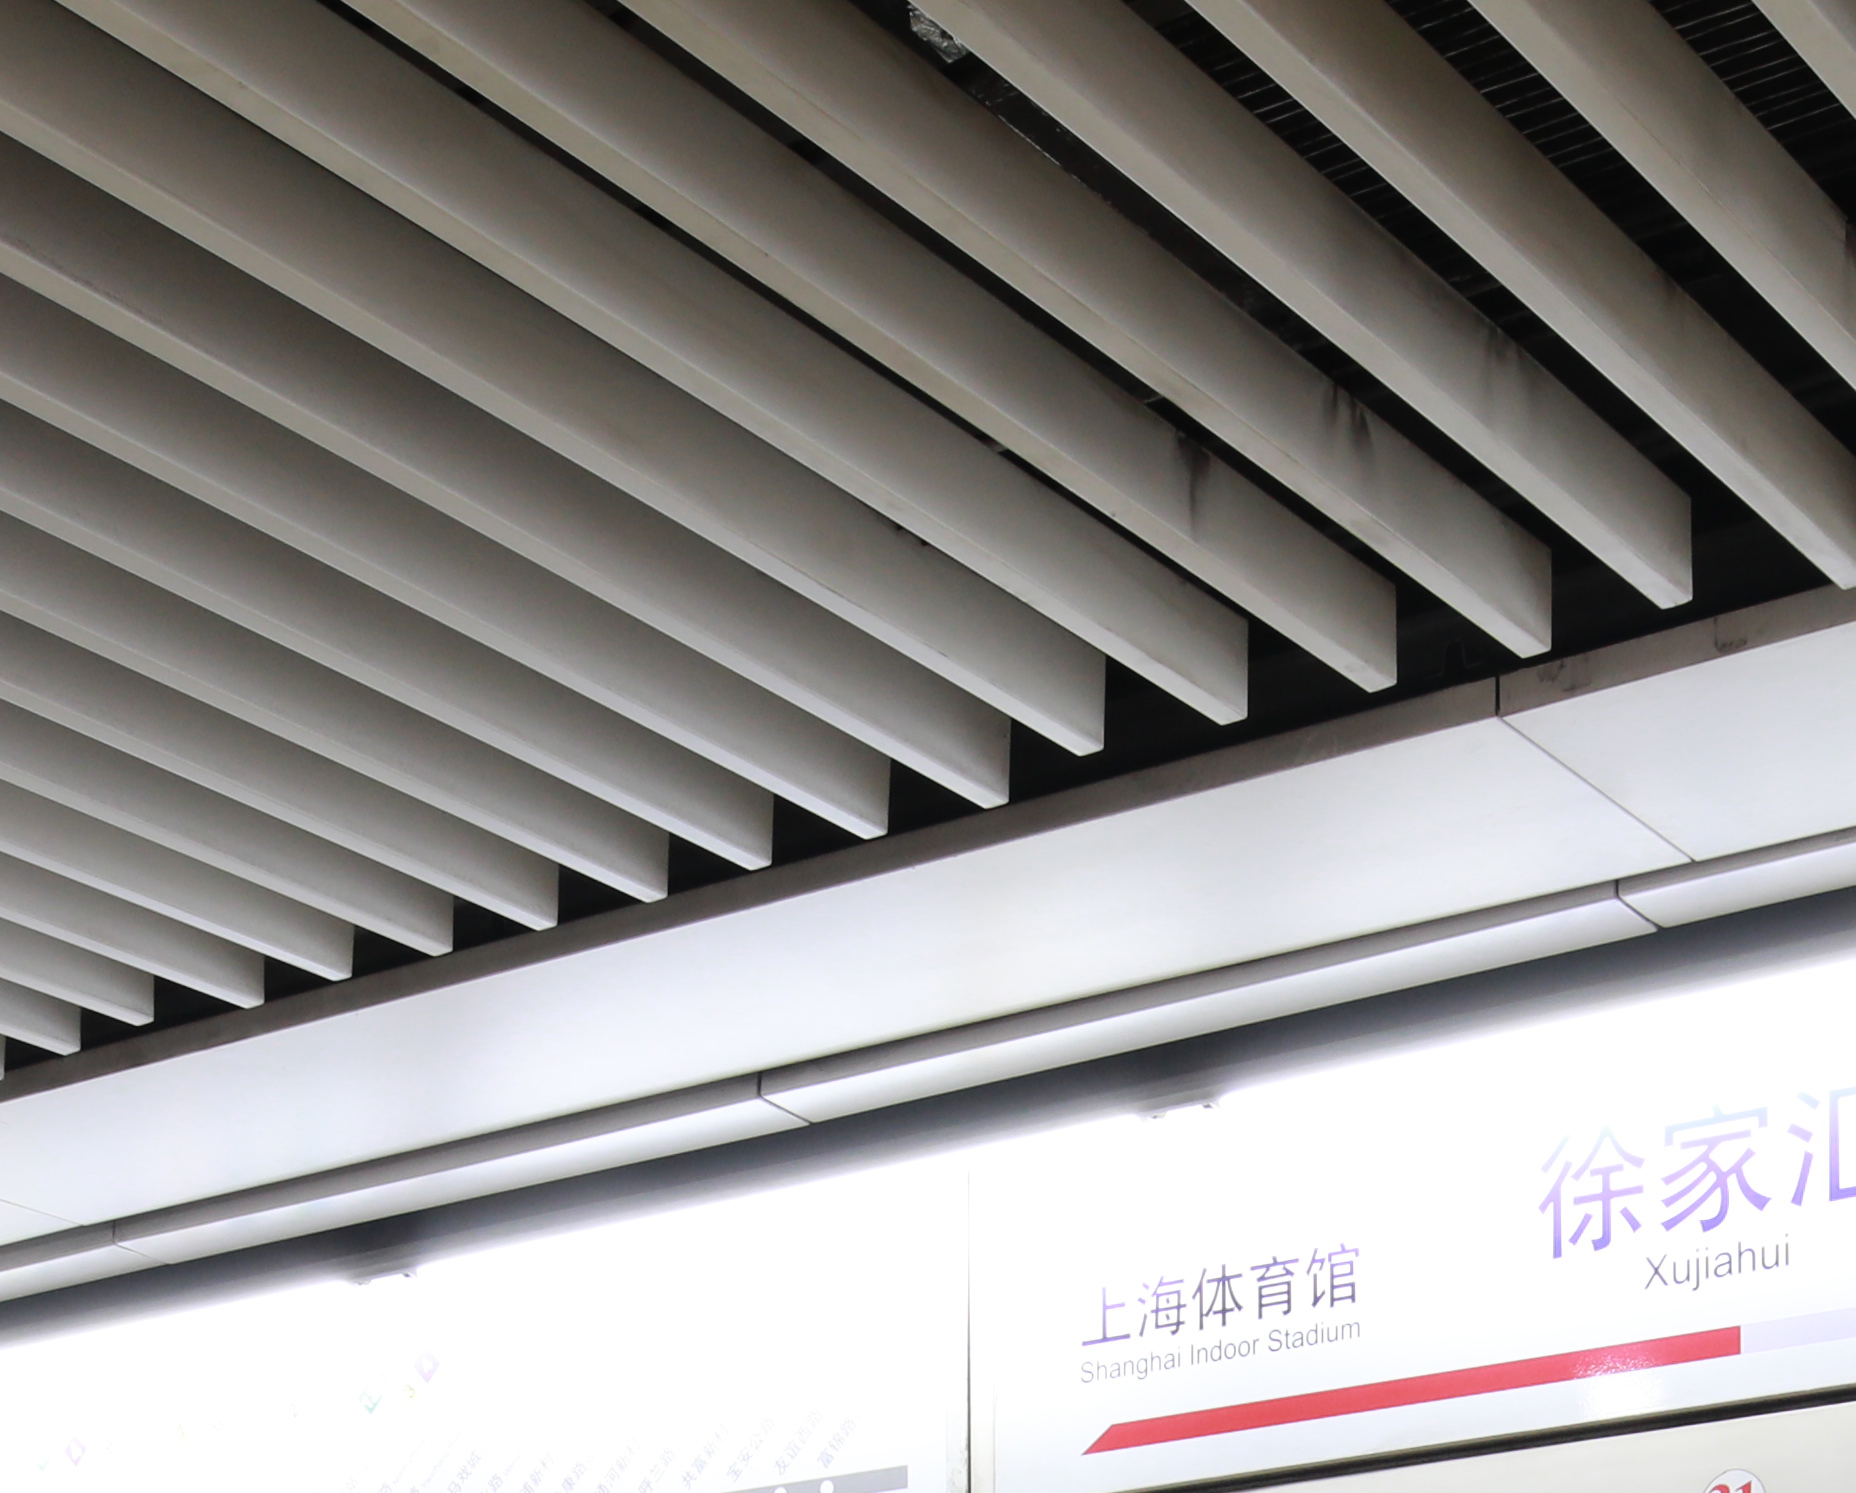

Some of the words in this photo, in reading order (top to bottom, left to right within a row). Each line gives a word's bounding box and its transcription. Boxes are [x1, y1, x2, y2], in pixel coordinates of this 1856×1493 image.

[1644, 1233, 1790, 1292] Xujiahui
[1081, 1243, 1360, 1347] 上海体育馆
[1081, 1347, 1181, 1384] Shanghai
[1190, 1337, 1260, 1367] Indoor
[1267, 1321, 1361, 1353] Stadium
